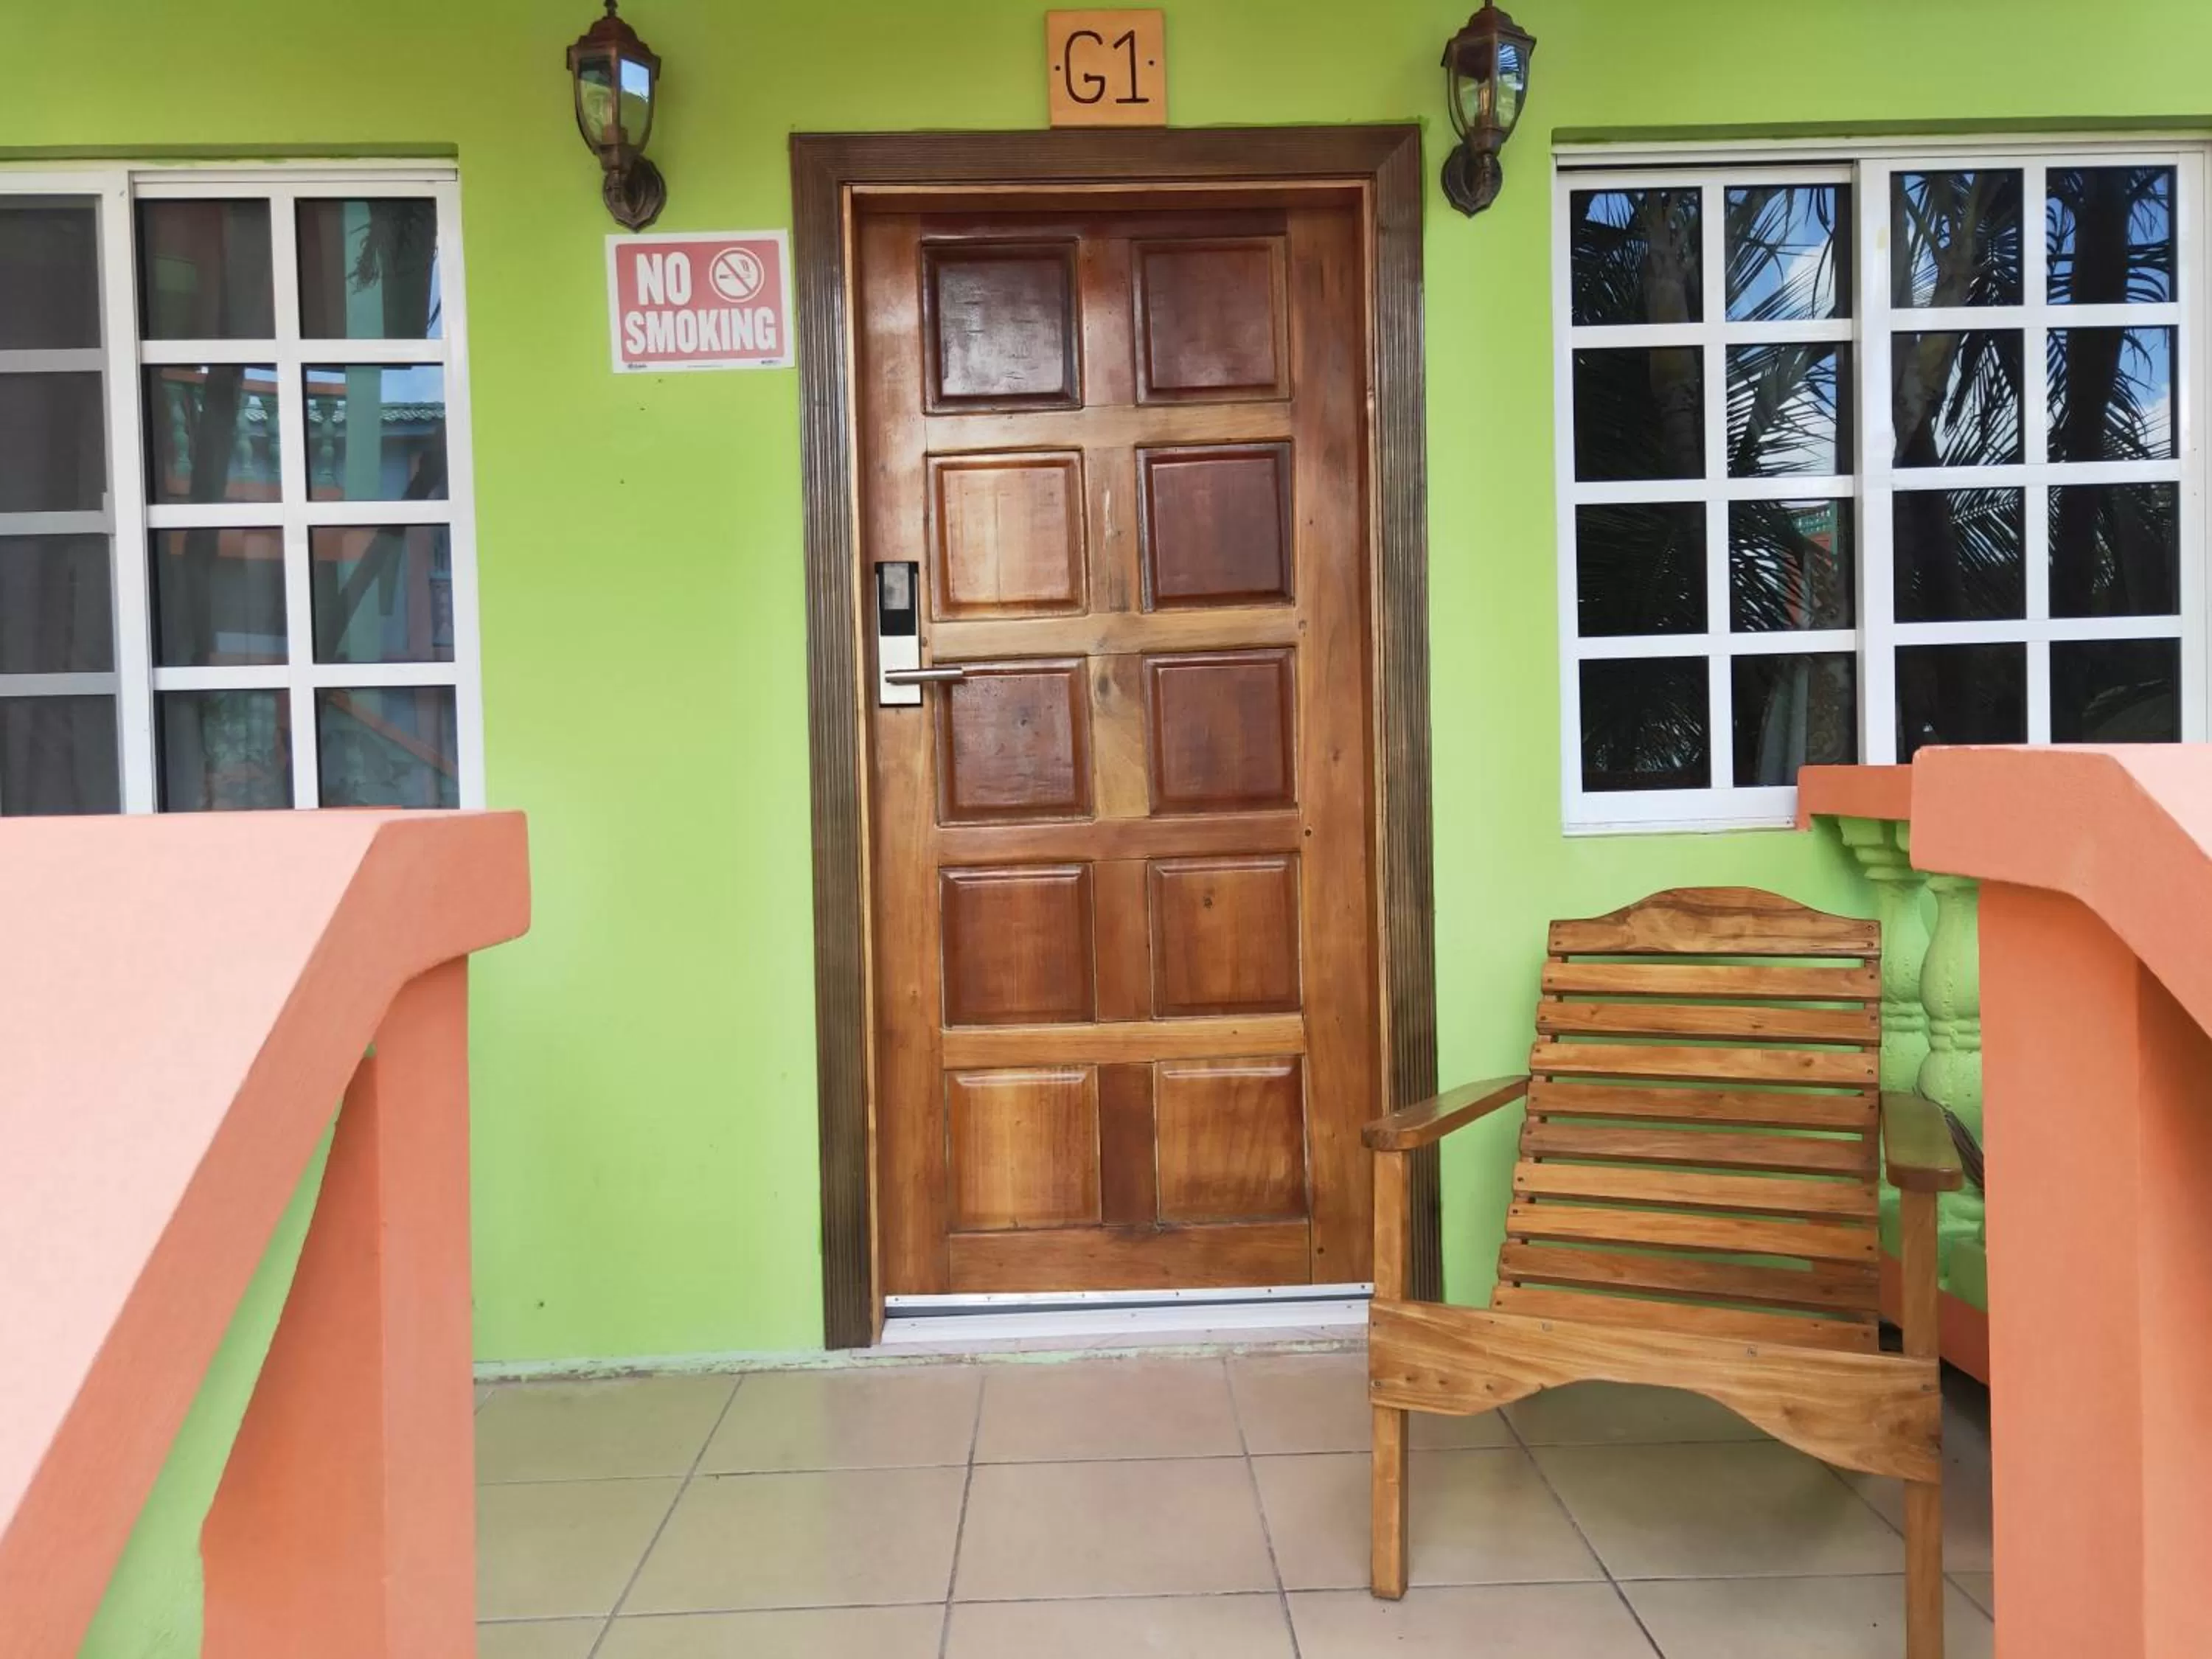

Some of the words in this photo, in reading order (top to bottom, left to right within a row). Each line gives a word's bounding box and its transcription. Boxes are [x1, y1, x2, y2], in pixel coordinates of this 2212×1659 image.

[1064, 29, 1150, 104] G1
[636, 251, 692, 306] NO
[625, 306, 777, 355] SMOKING
